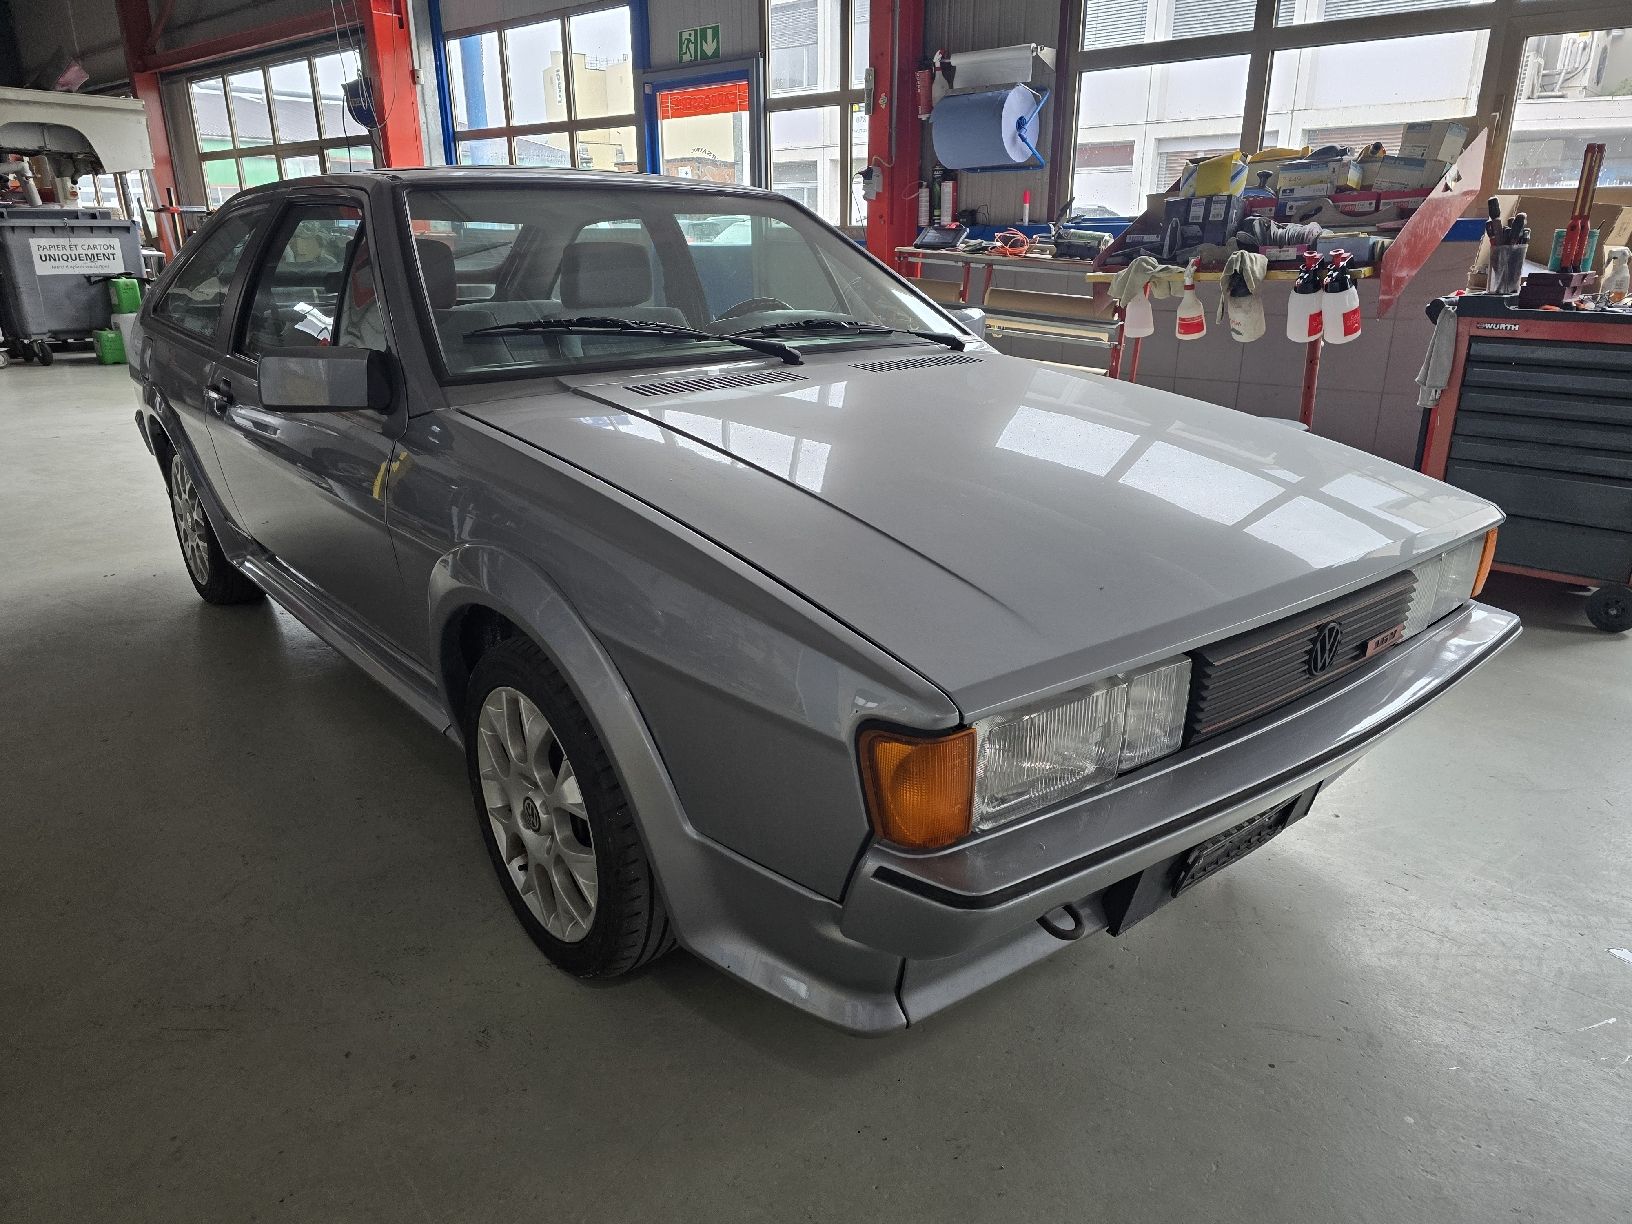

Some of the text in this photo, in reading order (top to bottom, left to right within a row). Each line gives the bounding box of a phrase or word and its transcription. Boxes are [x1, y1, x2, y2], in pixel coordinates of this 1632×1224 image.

[36, 244, 67, 252] PAPIER
[80, 243, 116, 251] CARTON
[39, 252, 117, 263] UNIQUEMENT
